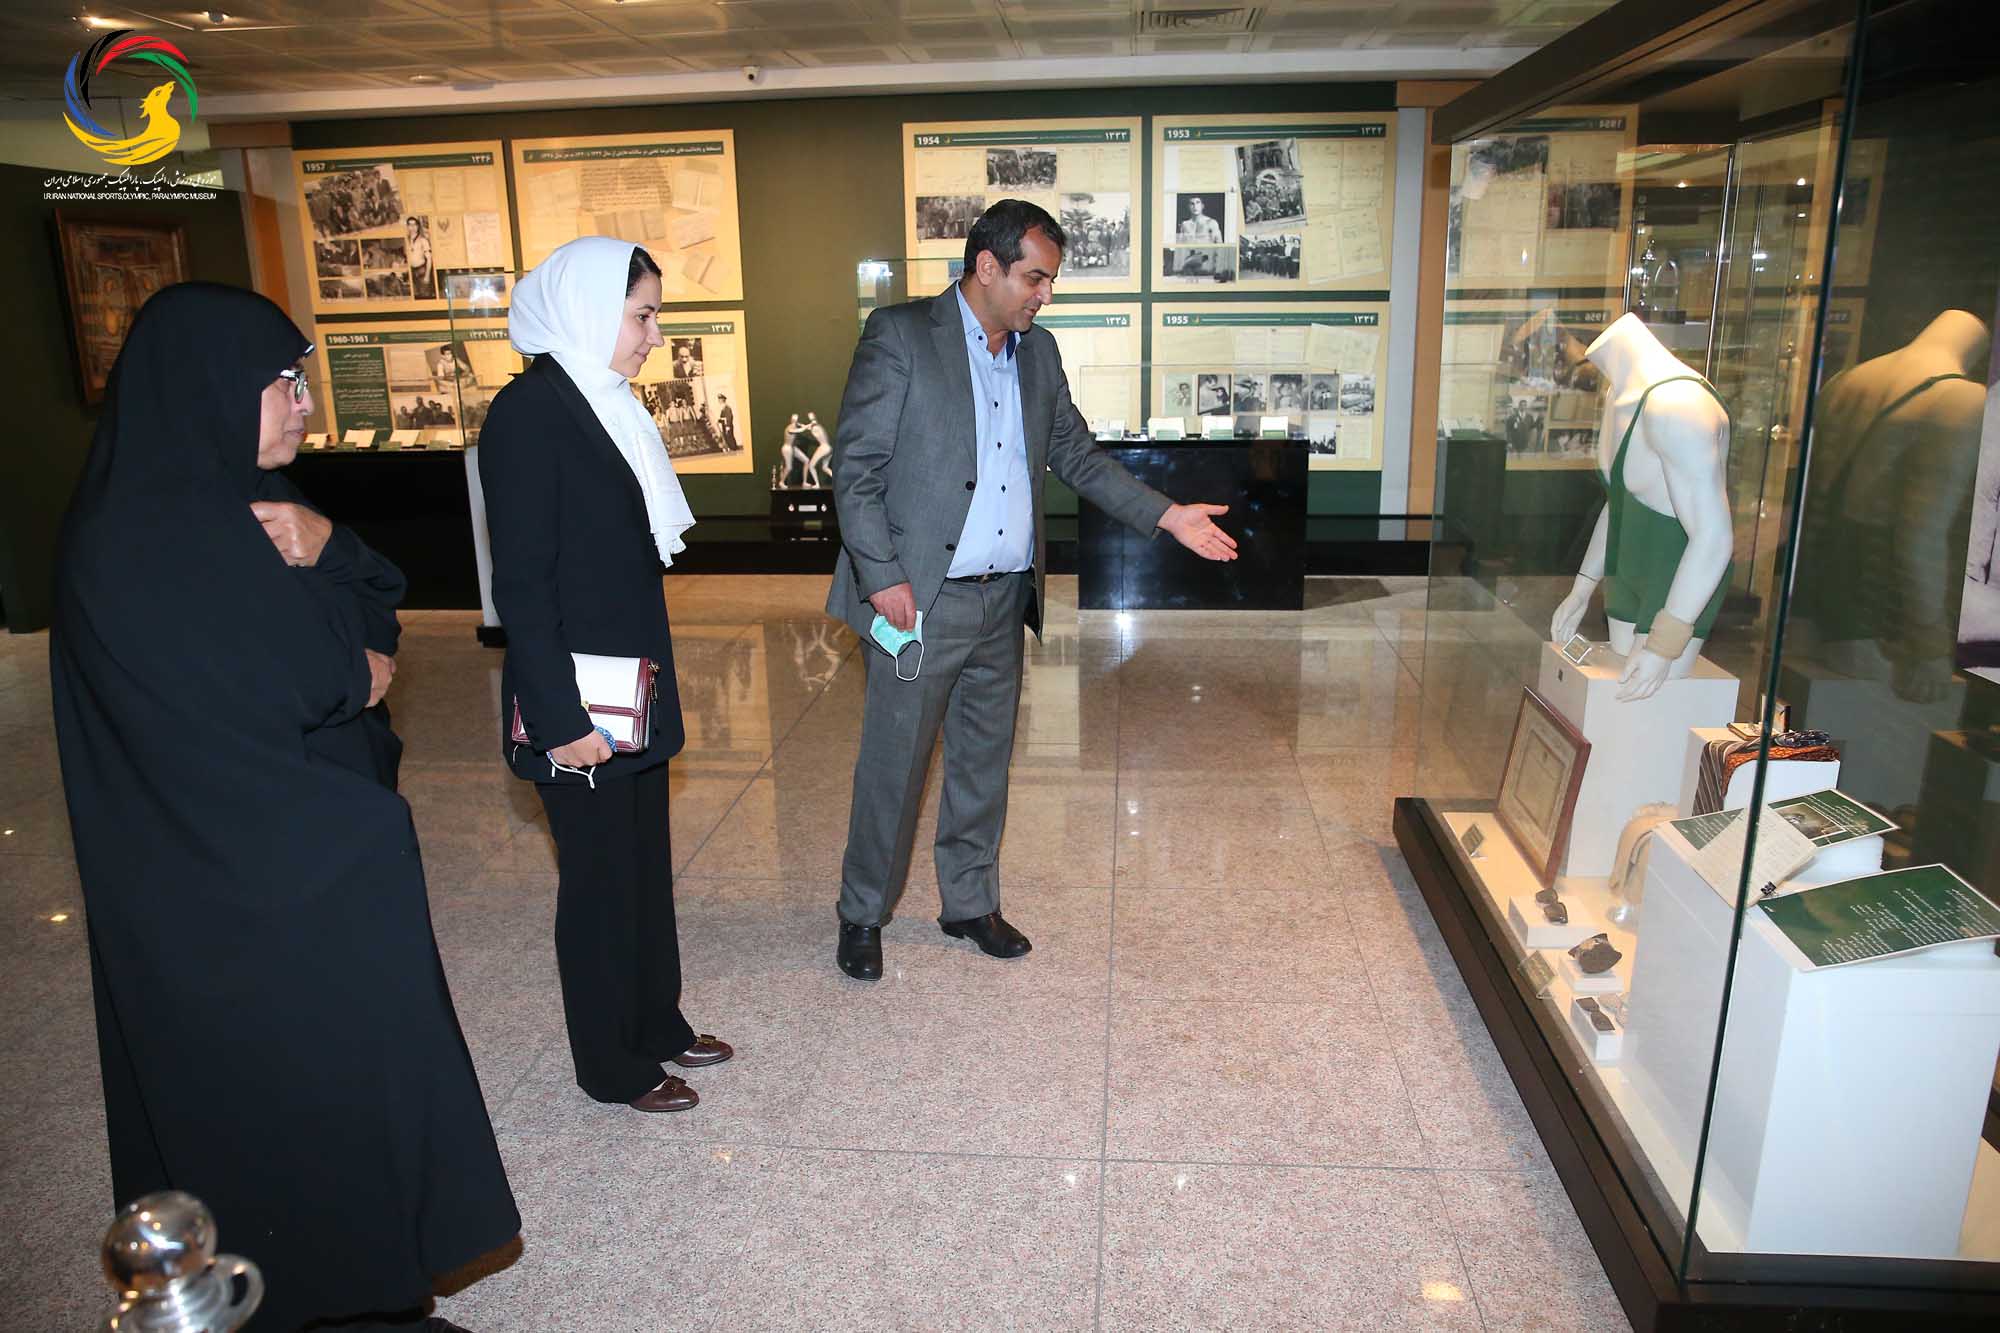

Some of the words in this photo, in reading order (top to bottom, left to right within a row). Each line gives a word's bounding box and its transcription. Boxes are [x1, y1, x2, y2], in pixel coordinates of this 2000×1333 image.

[1167, 130, 1190, 139] 1953
[917, 136, 940, 145] 1954
[306, 162, 325, 172] 1957
[1166, 315, 1189, 325] 1955
[328, 334, 369, 344] 1960-1961
